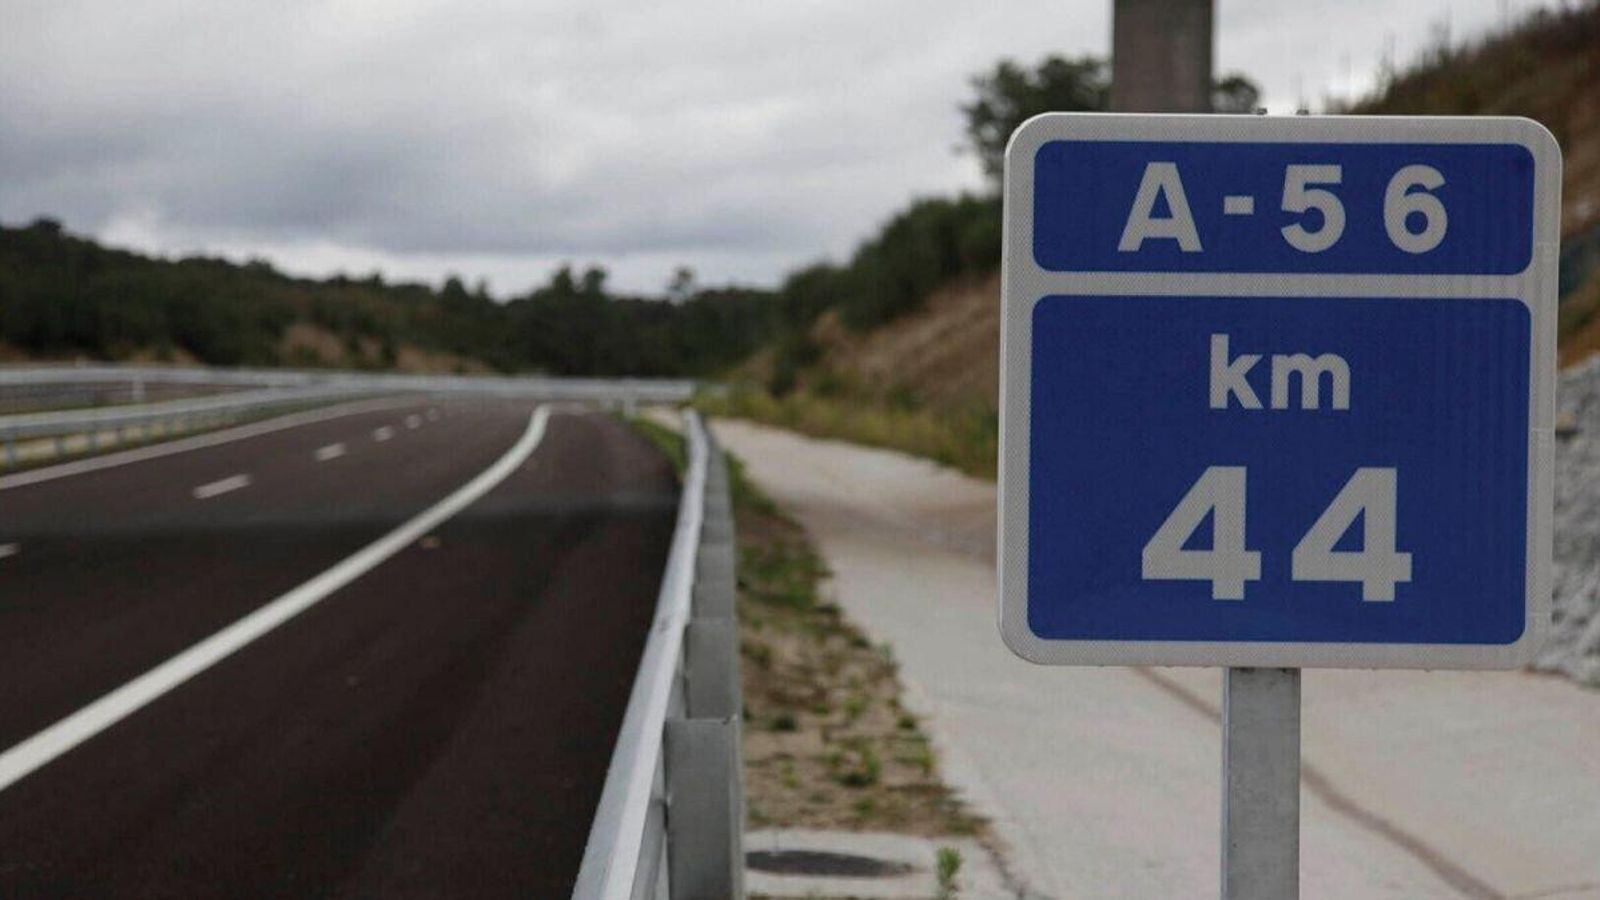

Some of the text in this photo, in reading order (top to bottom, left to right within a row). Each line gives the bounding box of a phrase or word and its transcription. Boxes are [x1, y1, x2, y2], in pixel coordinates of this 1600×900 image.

[1118, 161, 1448, 254] A-56
[1209, 333, 1351, 411] km
[1141, 465, 1413, 602] 44
